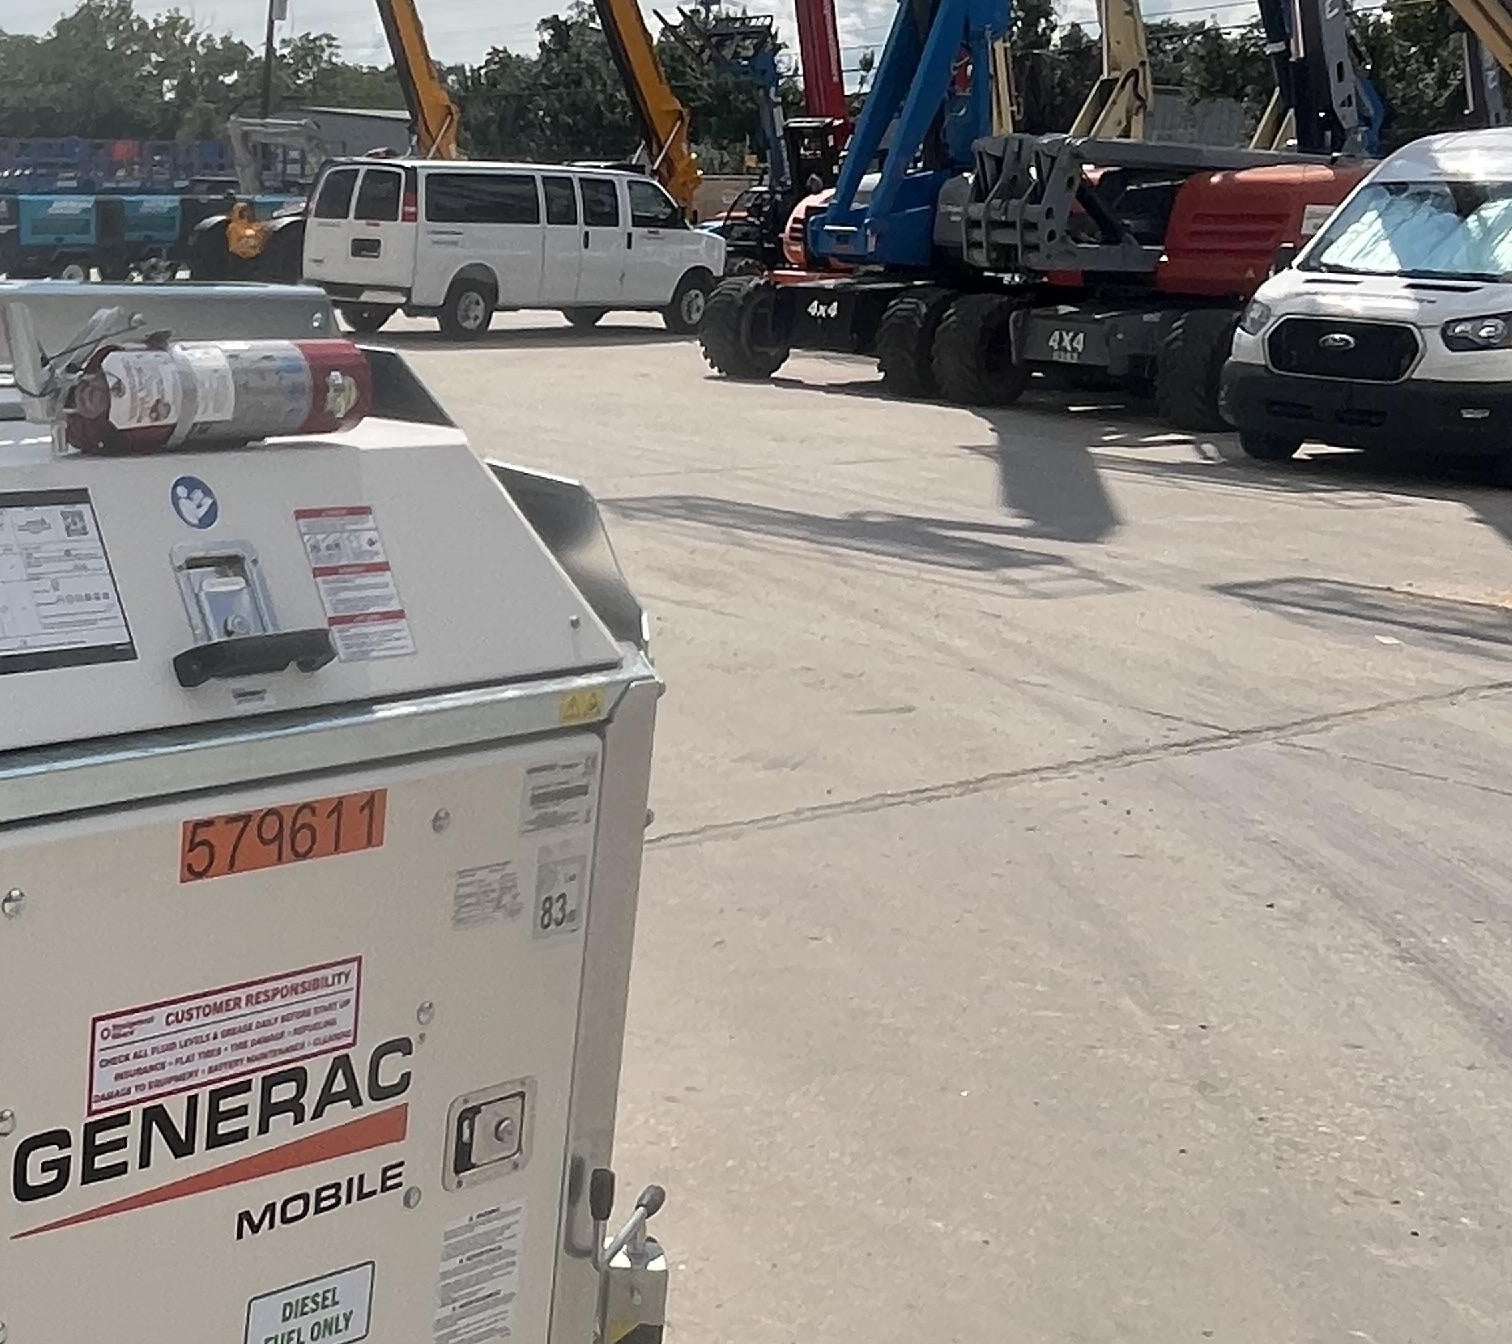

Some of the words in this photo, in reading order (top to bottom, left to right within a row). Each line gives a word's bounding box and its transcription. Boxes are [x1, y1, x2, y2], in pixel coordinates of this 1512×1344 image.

[1048, 330, 1086, 352] 4X4
[184, 790, 385, 880] 579611
[540, 891, 568, 931] 83
[165, 996, 242, 1027] CUSTOMER
[245, 968, 352, 1008] RESPONSIBILITY
[11, 1036, 413, 1203] GENERAC
[235, 1160, 406, 1241] MOBILE
[280, 1286, 341, 1324] DIESEL
